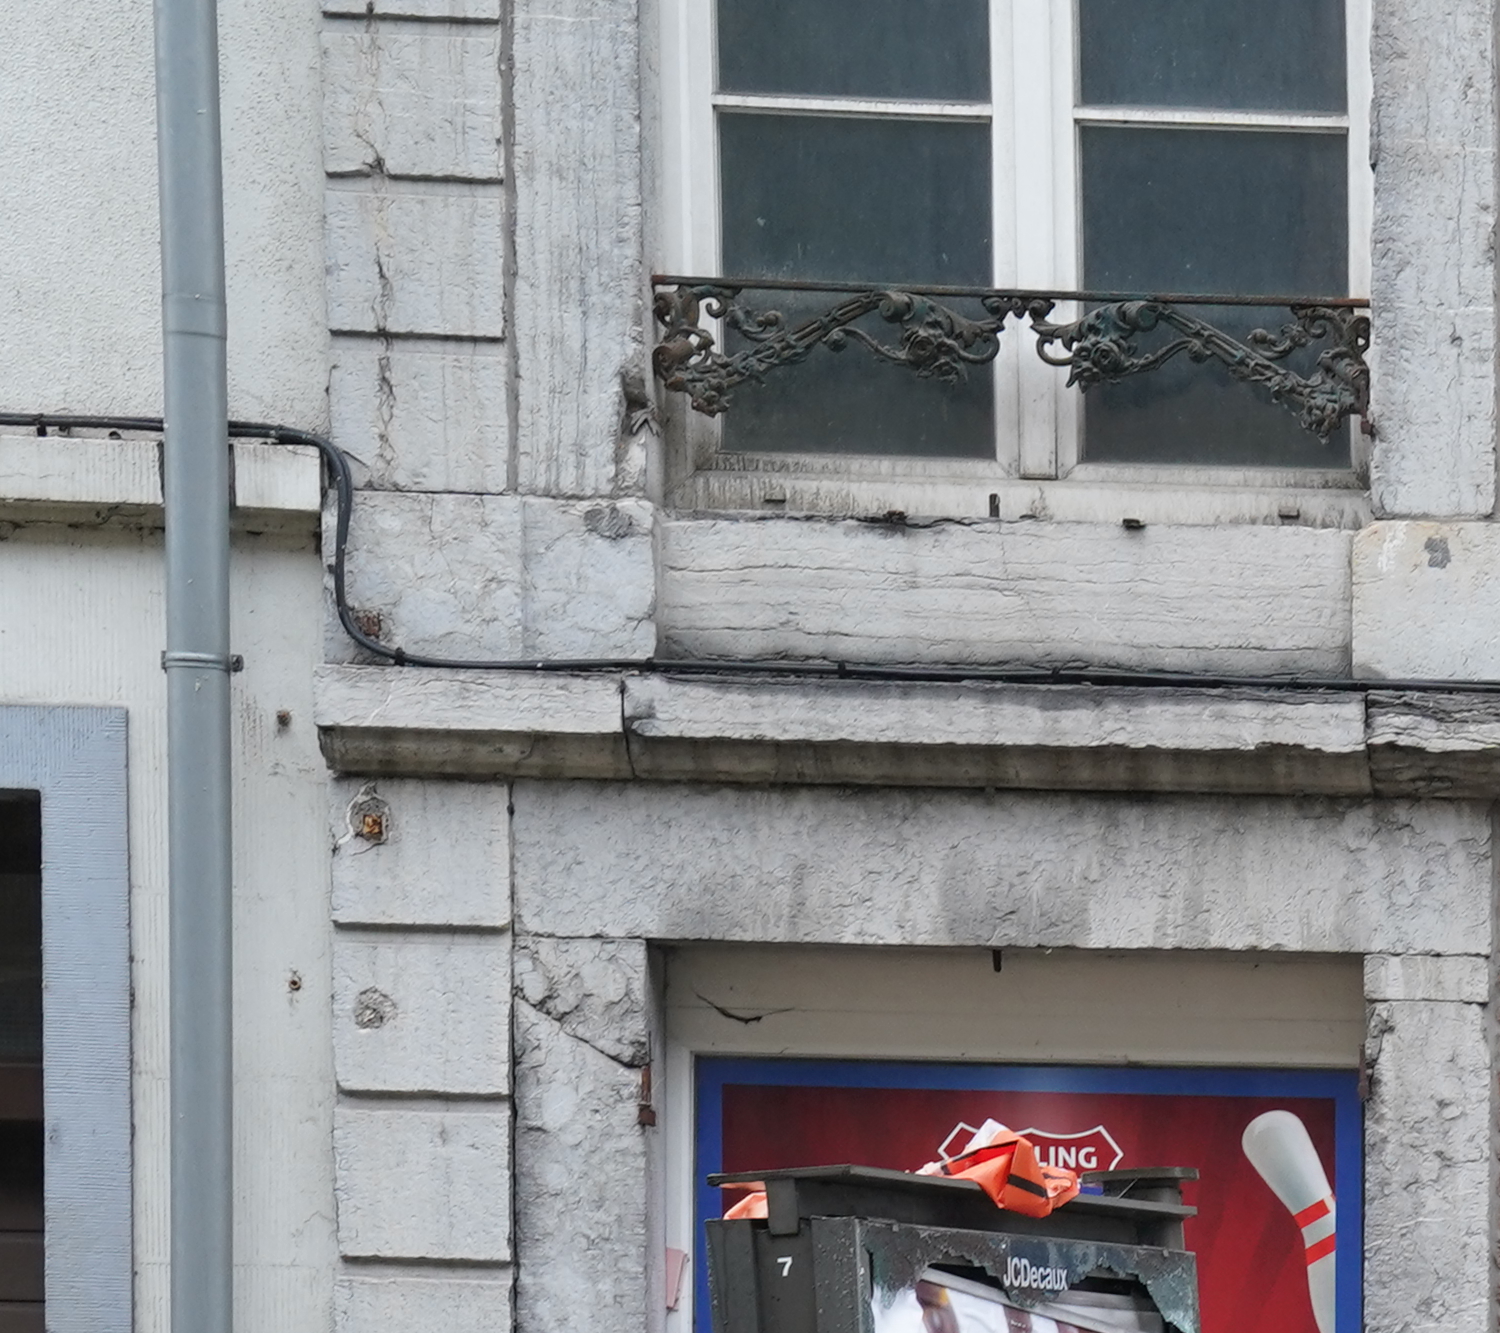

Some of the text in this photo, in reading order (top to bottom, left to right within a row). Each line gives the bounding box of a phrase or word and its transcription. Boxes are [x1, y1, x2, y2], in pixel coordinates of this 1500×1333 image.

[1034, 1146, 1098, 1169] LING
[777, 1256, 793, 1277] 7
[1003, 1256, 1069, 1291] JCDecaux
